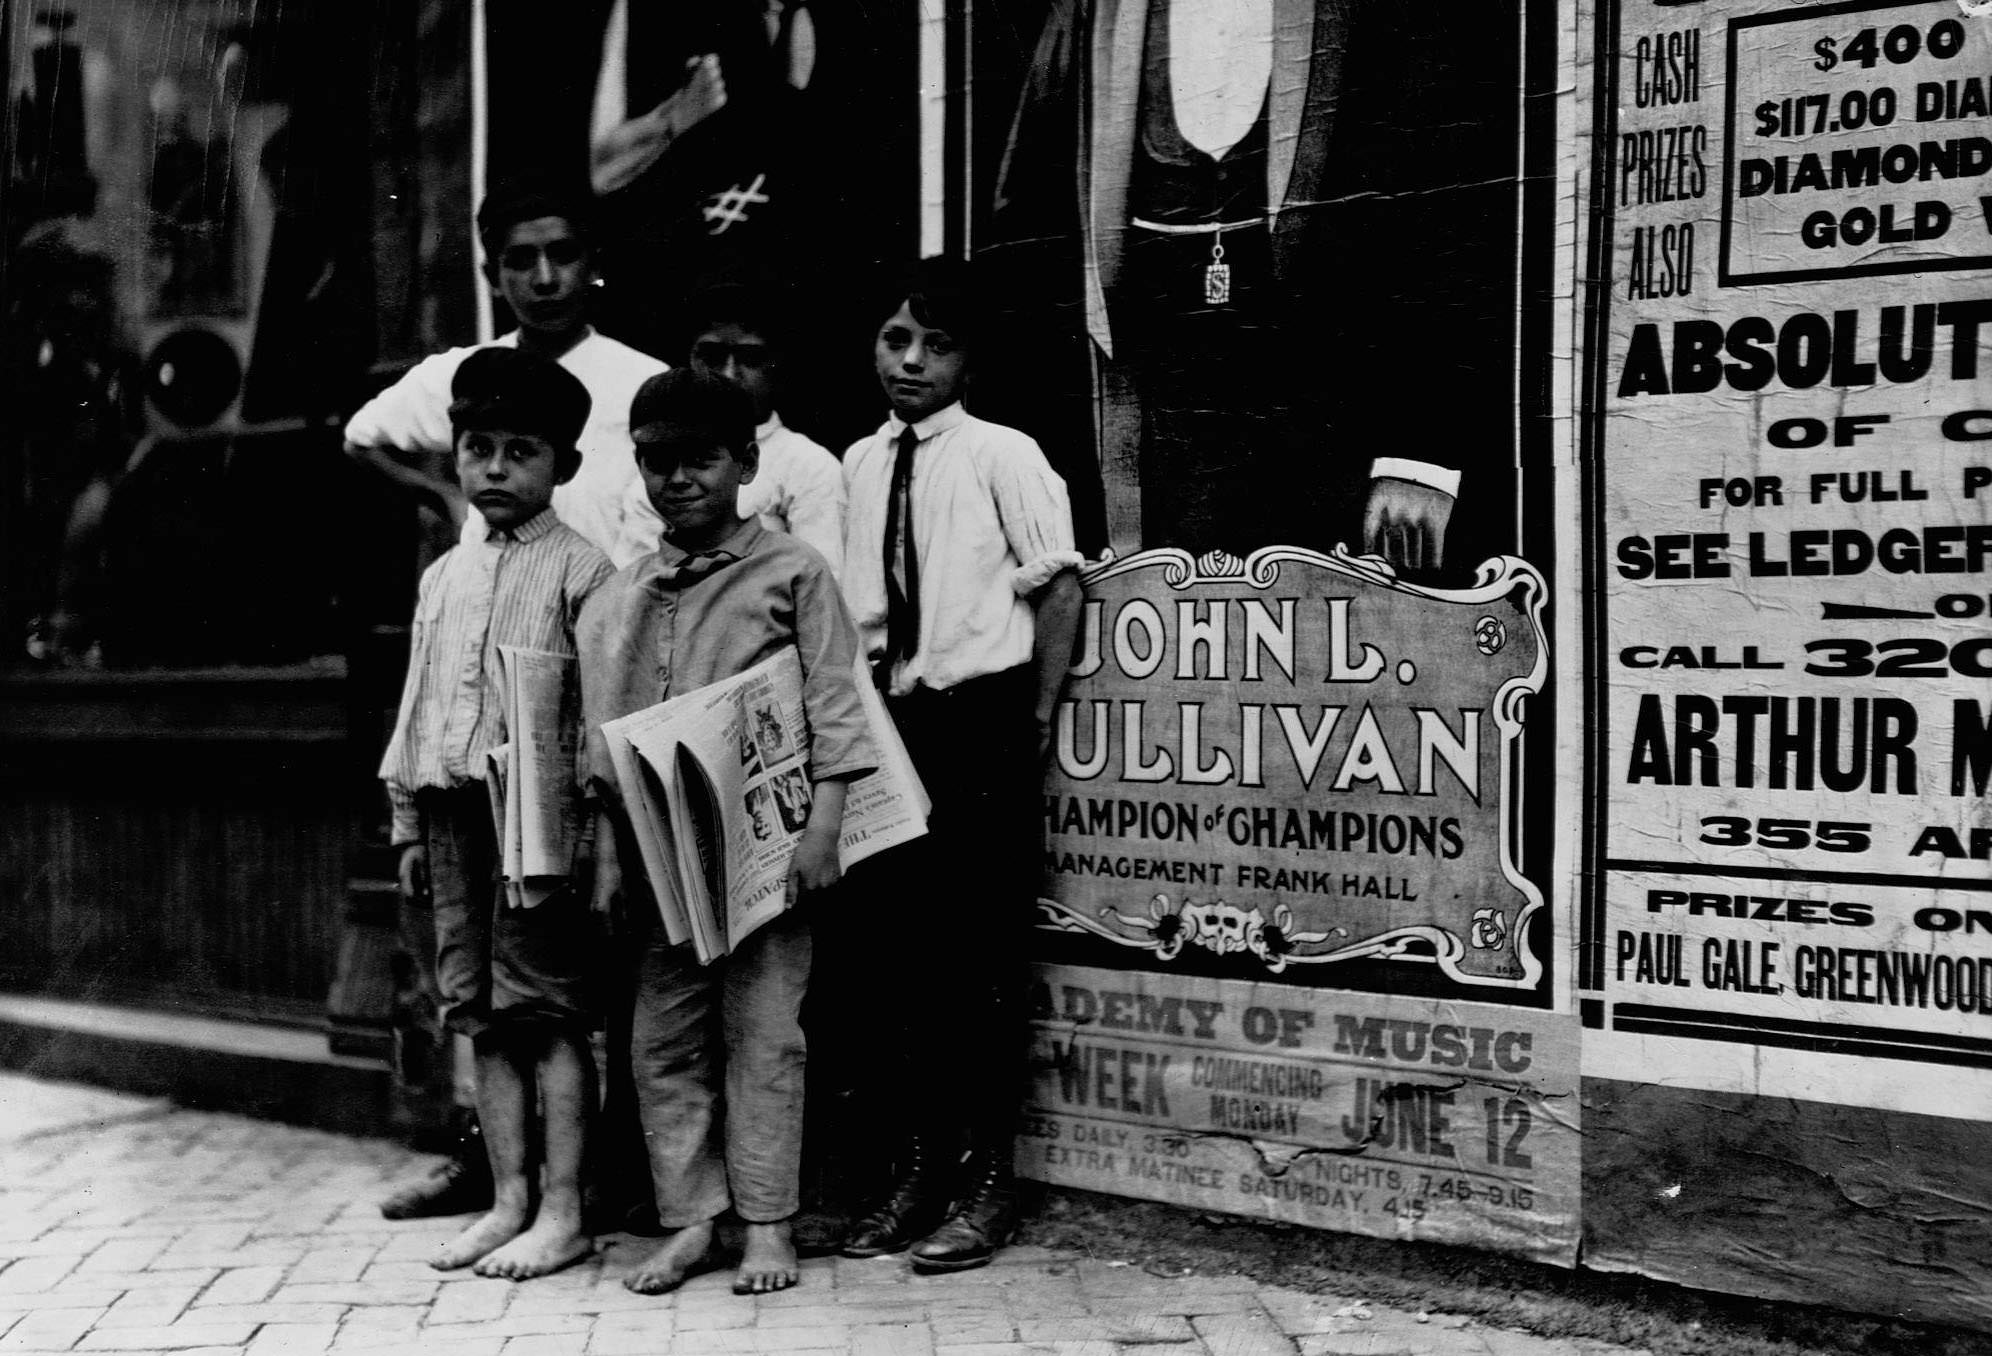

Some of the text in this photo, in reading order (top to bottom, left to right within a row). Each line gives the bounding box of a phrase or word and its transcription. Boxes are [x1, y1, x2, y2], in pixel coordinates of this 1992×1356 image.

[1636, 28, 1699, 108] CASH
[1814, 19, 1966, 72] $400
[1755, 76, 1992, 137] $117.00 DIA
[1622, 125, 1706, 206] PRIZES
[1740, 137, 1992, 198] DIAMOND
[1801, 200, 1952, 249] GOLD
[1628, 222, 1694, 300] ALSO
[1767, 414, 1891, 449] OF
[1700, 476, 1784, 509] FOR
[1811, 470, 1929, 504] FULL
[1617, 533, 1731, 580] SEE
[1068, 597, 1417, 685] JOHN L.
[1619, 646, 1785, 669] CALL
[1056, 700, 1484, 806] ULLIVAN
[1627, 693, 1919, 796] ARTHUR
[1042, 796, 1198, 844] HAMPION
[1227, 807, 1464, 859] CHAMPIONS
[1700, 816, 1873, 853] 355
[1237, 866, 1330, 895] FRANK
[1342, 873, 1418, 902] HALL
[1647, 889, 1875, 927] PRIZES
[1616, 930, 1690, 988] PAUL
[1703, 937, 1785, 996] GALE,
[1241, 1005, 1314, 1049] OF
[1335, 1013, 1533, 1074] MUSIC
[1191, 1056, 1532, 1169] COMMENCING JUNE 12
[1045, 1146, 1115, 1173] EXTRA
[1128, 1156, 1225, 1190] MATINEE
